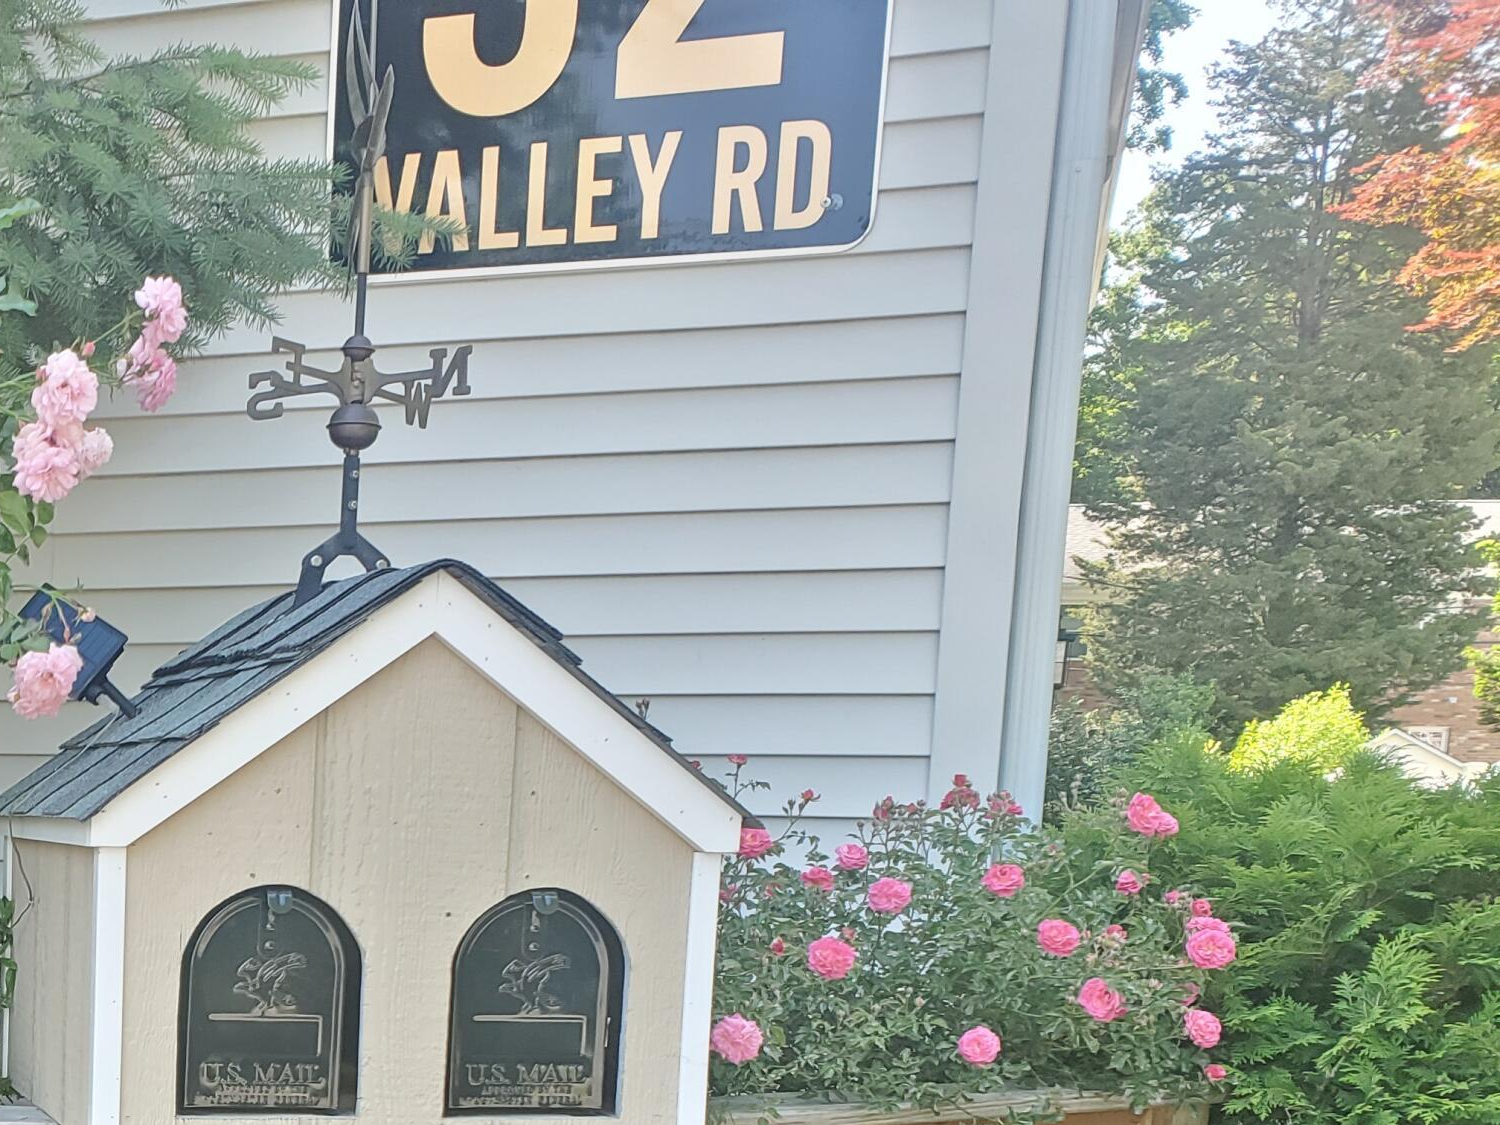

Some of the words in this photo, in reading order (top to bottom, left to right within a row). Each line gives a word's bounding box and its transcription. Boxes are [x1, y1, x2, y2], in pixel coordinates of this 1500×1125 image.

[374, 131, 683, 256] VALLEY
[712, 120, 833, 235] RD
[200, 1062, 247, 1086] U.S.
[252, 1062, 324, 1085] MAIL
[465, 1063, 510, 1086] U.S.
[516, 1062, 588, 1085] MAIL
